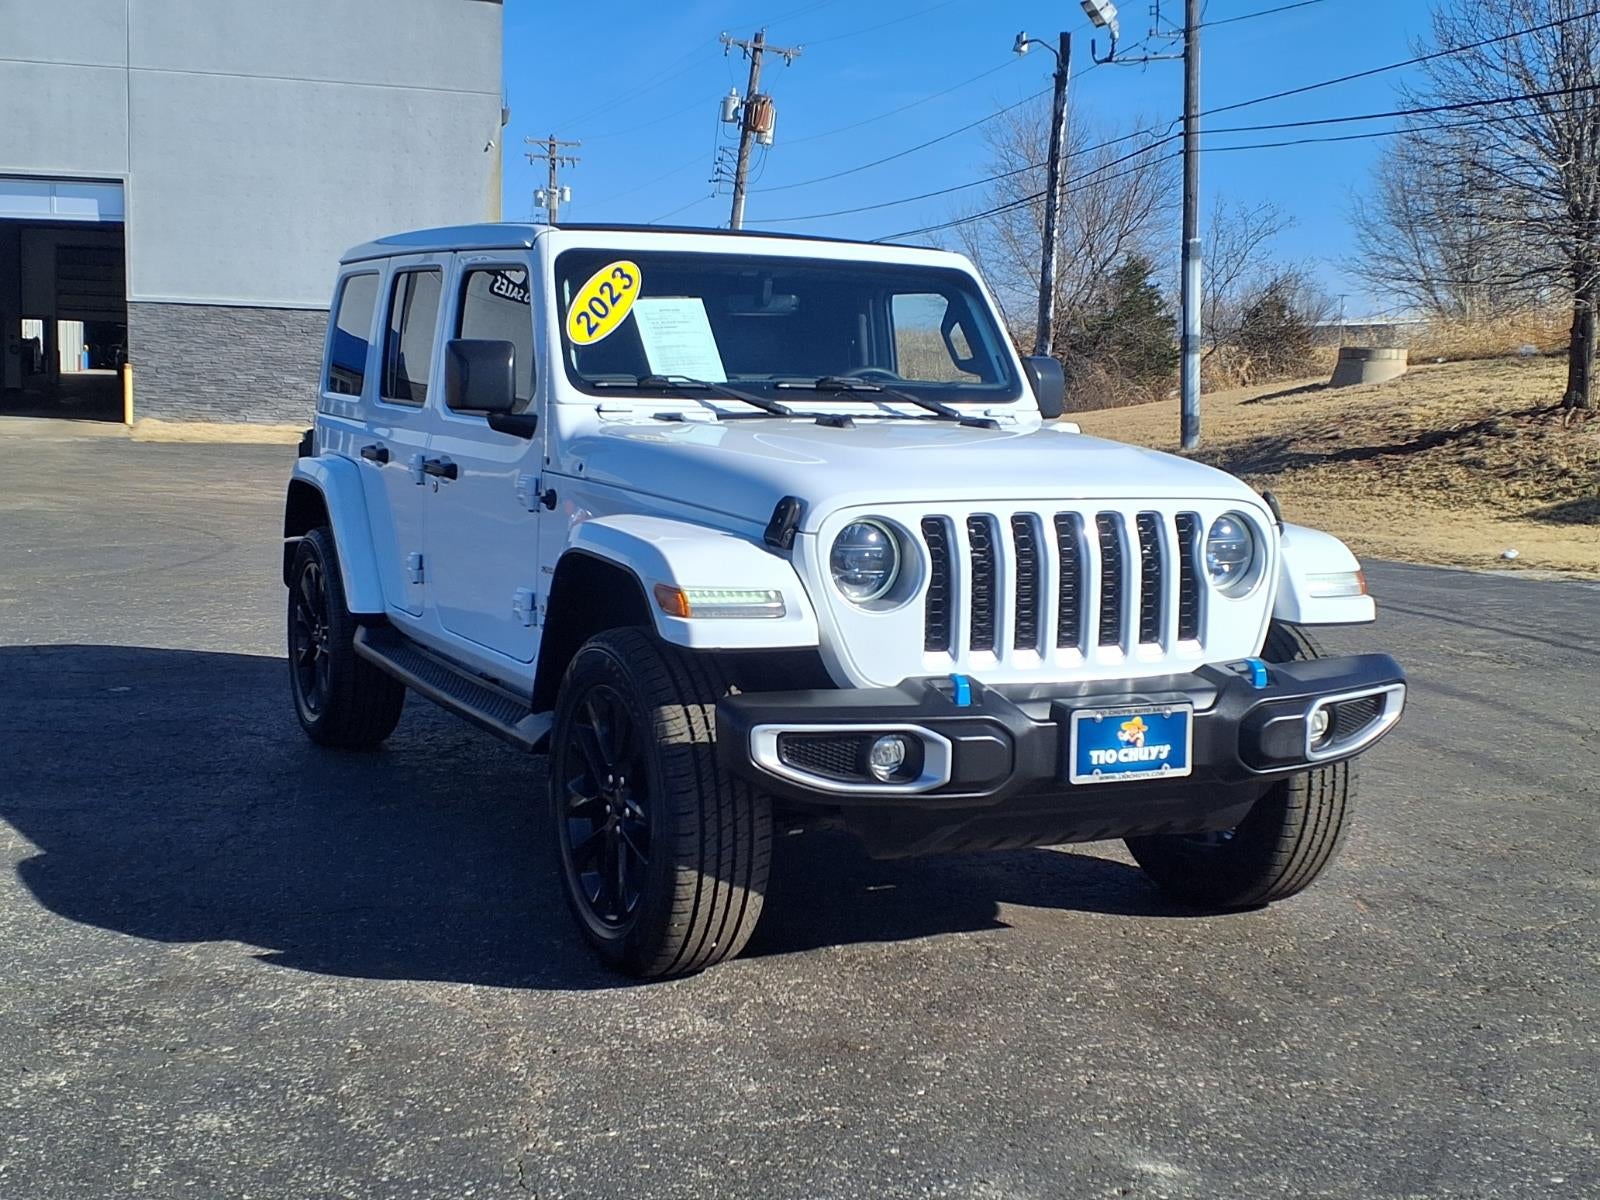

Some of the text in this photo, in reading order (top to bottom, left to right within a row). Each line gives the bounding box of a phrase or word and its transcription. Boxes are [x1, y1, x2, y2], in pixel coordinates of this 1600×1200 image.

[576, 267, 634, 337] 2023
[1089, 744, 1171, 765] TIO CHUY'S
